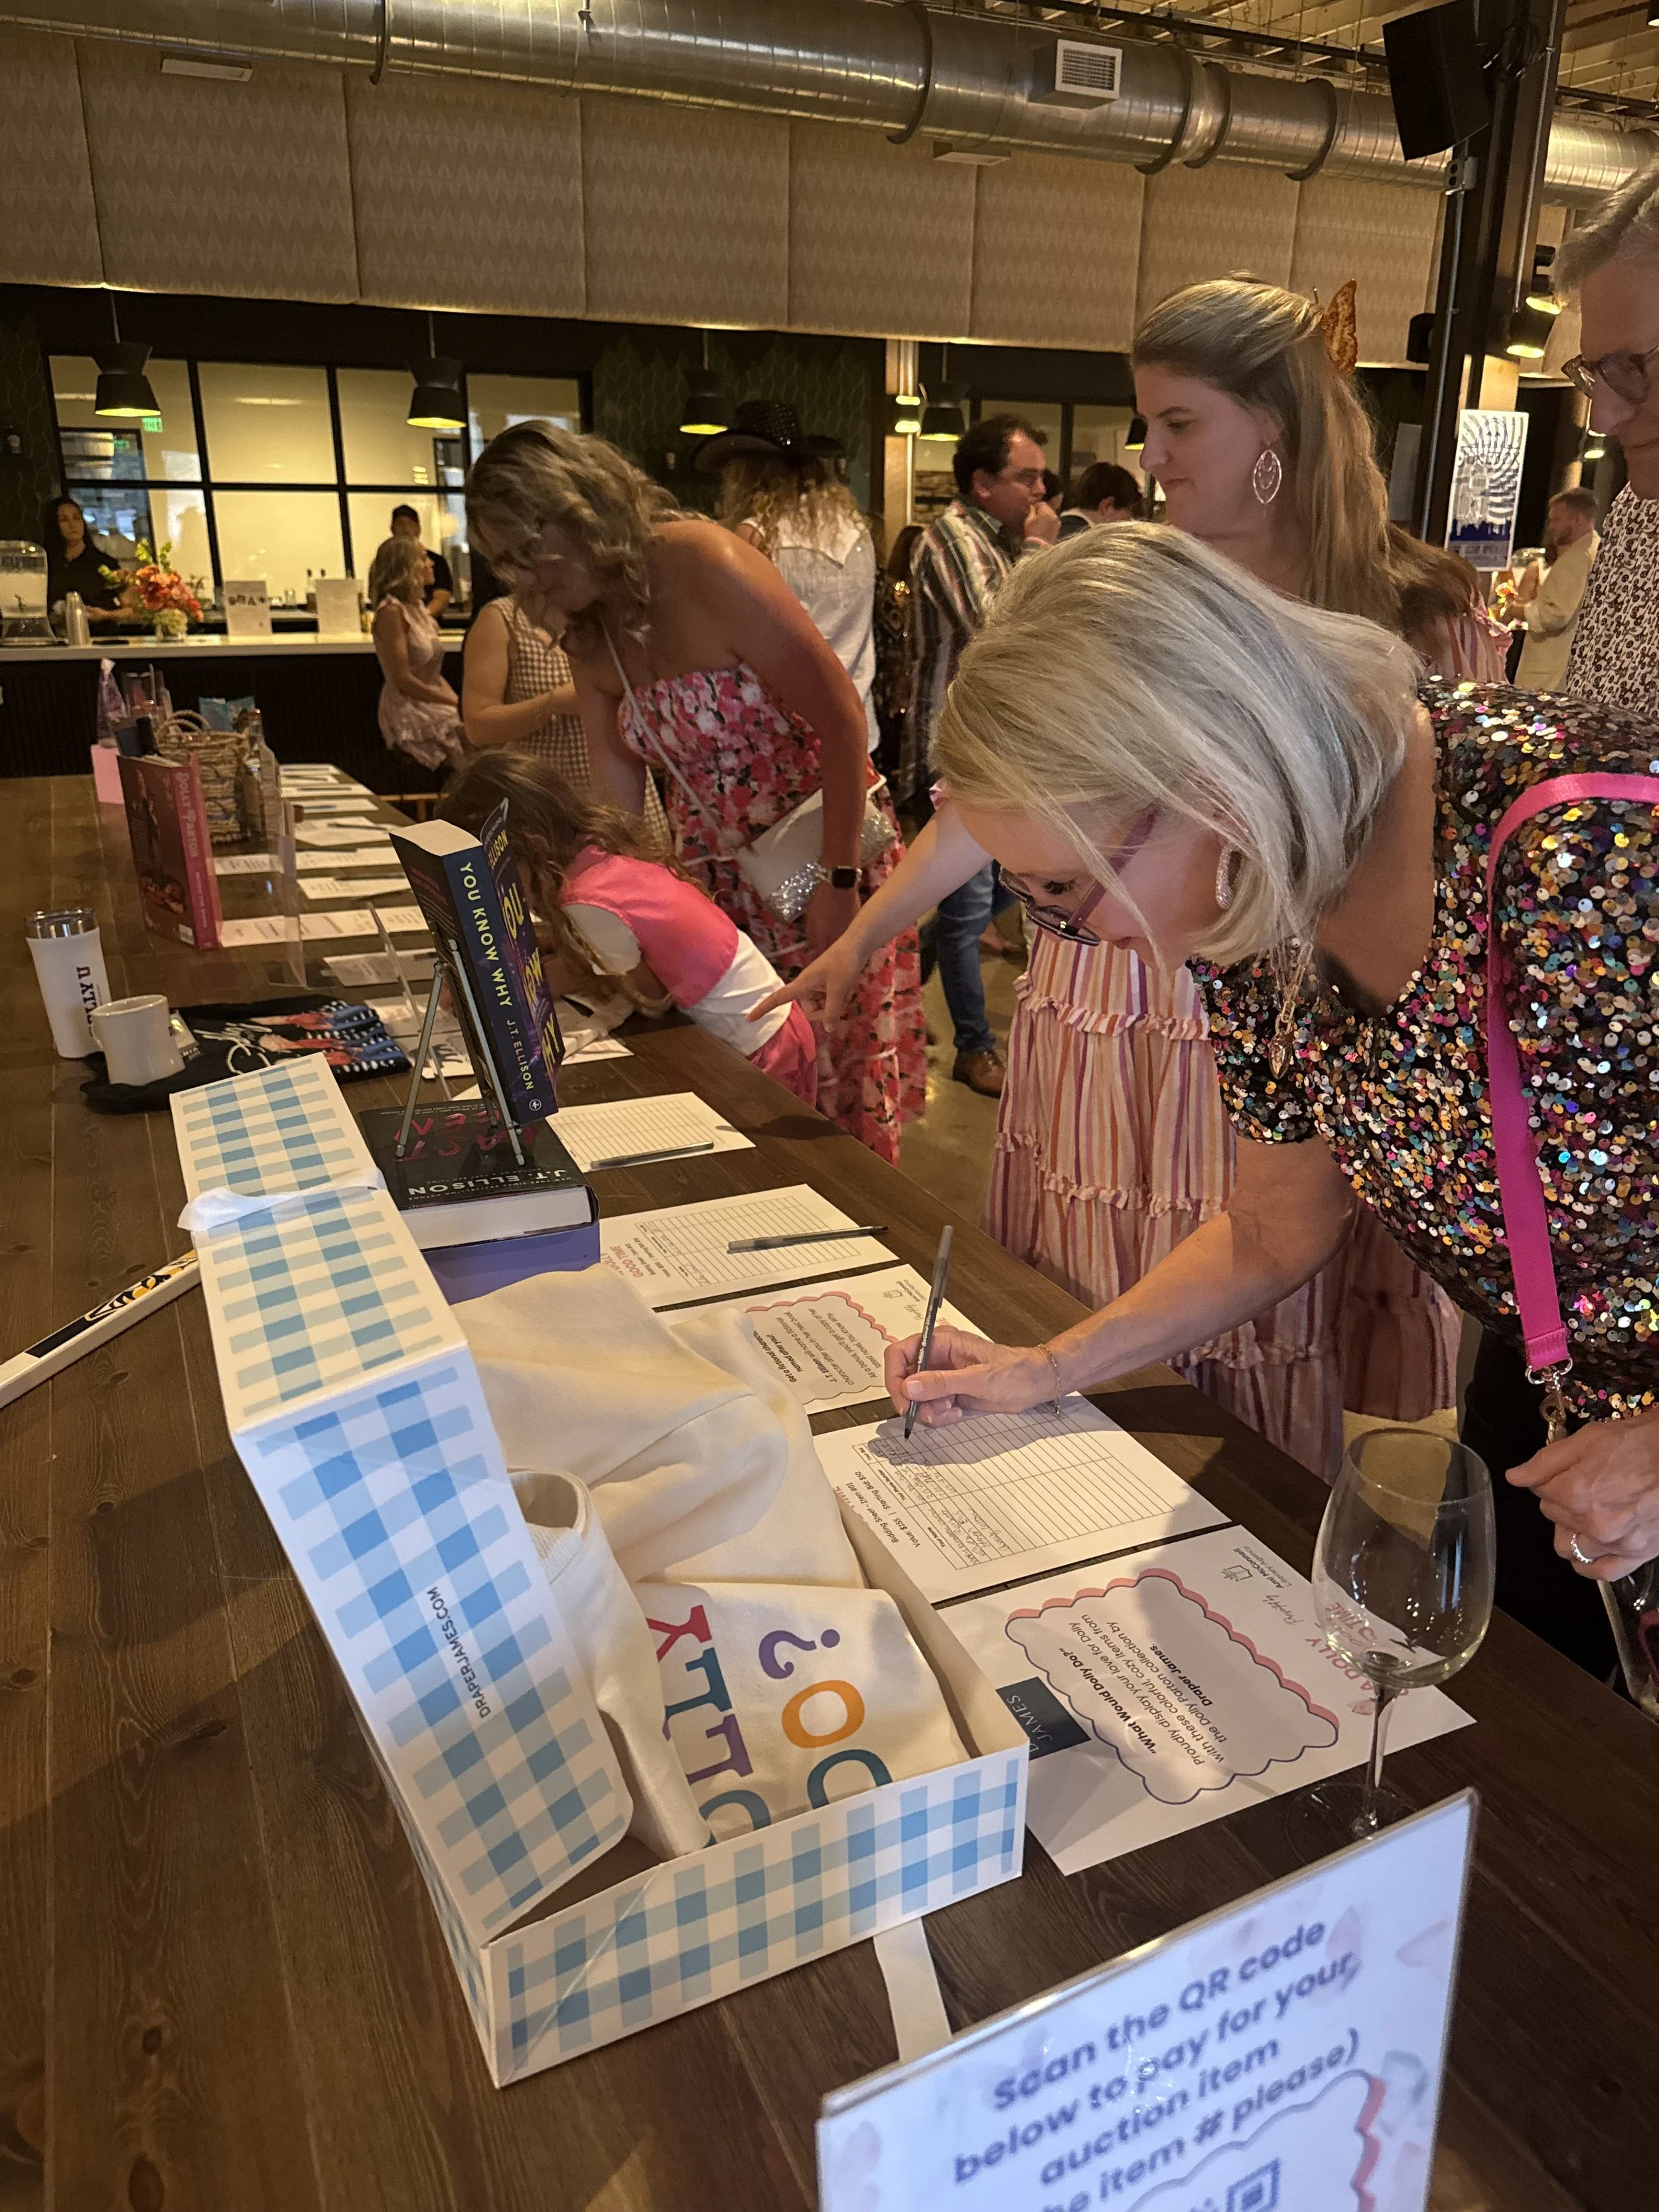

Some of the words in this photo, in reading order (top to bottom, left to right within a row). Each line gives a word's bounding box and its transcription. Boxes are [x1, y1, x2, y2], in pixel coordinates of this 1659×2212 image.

[502, 882, 524, 940] OU
[460, 861, 480, 901] YOU
[472, 907, 498, 960] KNOW
[491, 967, 512, 1005] WHY
[506, 1019, 518, 1039] J.T.
[513, 1041, 534, 1089] ELLISON
[392, 1128, 536, 1162] LAST
[528, 1169, 566, 1179] J.T.
[408, 1175, 519, 1195] ELLISON
[609, 1244, 625, 1260] TIME
[621, 1258, 644, 1278] GOOD
[774, 1317, 794, 1335] fictional
[766, 1333, 782, 1347] you!
[794, 1337, 809, 1352] name
[813, 1341, 826, 1352] you
[831, 1331, 844, 1343] get
[766, 1349, 786, 1371] fictional
[776, 1342, 789, 1358] after
[804, 1348, 816, 1359] will
[820, 1348, 834, 1364] after
[784, 1355, 803, 1372] named
[812, 1357, 829, 1374] Ellison
[865, 1355, 882, 1368] latest
[785, 1371, 797, 1382] Get
[830, 1361, 854, 1385] character
[845, 1481, 857, 1491] #01
[854, 1471, 866, 1481] $50
[877, 1469, 891, 1483] Number
[854, 1491, 868, 1504] Item
[888, 1481, 900, 1494] Phone
[871, 1489, 891, 1510] Starting
[867, 1507, 883, 1522] Sheet
[893, 1517, 908, 1530] $155
[879, 1522, 899, 1543] Bidding
[904, 1530, 920, 1548] Value:
[926, 1526, 938, 1540] Name
[936, 1538, 946, 1548] Your
[1233, 1546, 1269, 1578] McConnell
[1242, 1546, 1267, 1570] Agency
[1265, 1566, 1291, 1587] Literary
[1266, 1573, 1284, 1588] Ami
[1068, 1622, 1091, 1645] Dolly
[1081, 1614, 1102, 1634] from
[1106, 1621, 1121, 1633] by
[427, 1587, 491, 1718] DRAPERJAMES.COM
[1086, 1643, 1102, 1655] for
[1100, 1634, 1125, 1659] items
[1118, 1633, 1159, 1672] collection
[1100, 1655, 1120, 1674] love
[1121, 1659, 1144, 1678] cozy
[1305, 1637, 1362, 1681] DOLLY
[1079, 1668, 1104, 1694] Dolly
[1116, 1674, 1141, 1694] your
[1157, 1673, 1189, 1703] Parton
[1178, 1675, 1212, 1706] Draper
[1141, 1678, 1178, 1713] colorful,
[1099, 1690, 1131, 1722] Would
[1135, 1696, 1170, 1728] display
[1185, 1703, 1210, 1726] Dolly
[759, 1629, 893, 1810] DO?
[1006, 1695, 1052, 1739] JAMES
[1176, 1714, 1204, 1741] these
[1208, 1726, 1226, 1743] the
[1167, 1730, 1204, 1765] Proudly
[1202, 1741, 1224, 1763] with
[995, 2041, 1098, 2112] Scan
[1106, 2003, 1170, 2051] the
[1179, 1966, 1230, 2012] QR
[1238, 1922, 1325, 1982] code
[954, 2098, 1081, 2183] below
[1088, 2075, 1127, 2110] to
[1137, 2029, 1208, 2095] pay
[1217, 1998, 1266, 2043] for
[1040, 2088, 1190, 2185] auction
[1198, 2037, 1279, 2099] item
[1099, 2137, 1185, 2201] item
[1193, 2108, 1224, 2144] #
[1232, 2027, 1360, 2132] please)
